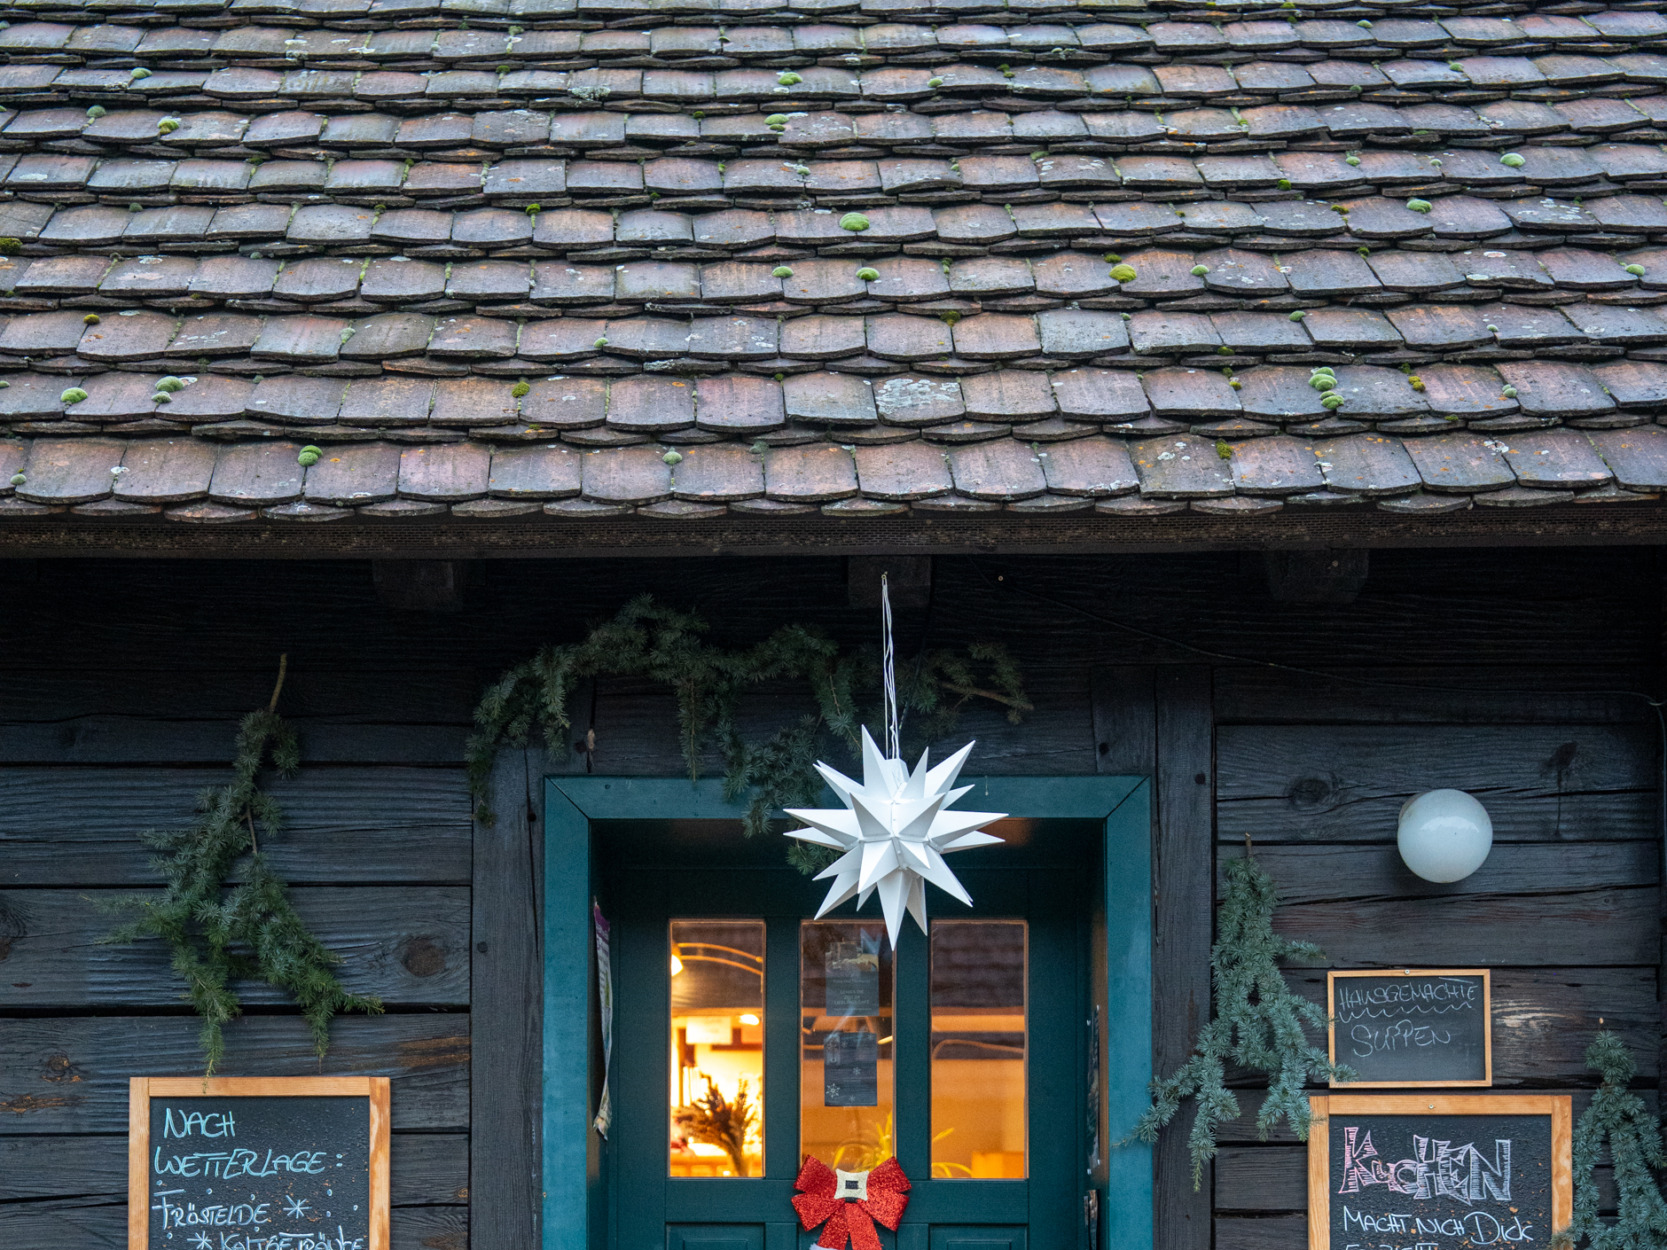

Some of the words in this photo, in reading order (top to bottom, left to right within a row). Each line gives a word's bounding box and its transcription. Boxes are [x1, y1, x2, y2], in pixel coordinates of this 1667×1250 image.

[1351, 1019, 1451, 1058] SUPPEN
[164, 1107, 236, 1138] NACH
[1338, 1126, 1512, 1206] KUCHEN
[1343, 1205, 1412, 1233] MACHT
[1415, 1217, 1465, 1236] NICH
[1463, 1211, 1534, 1245] DICK
